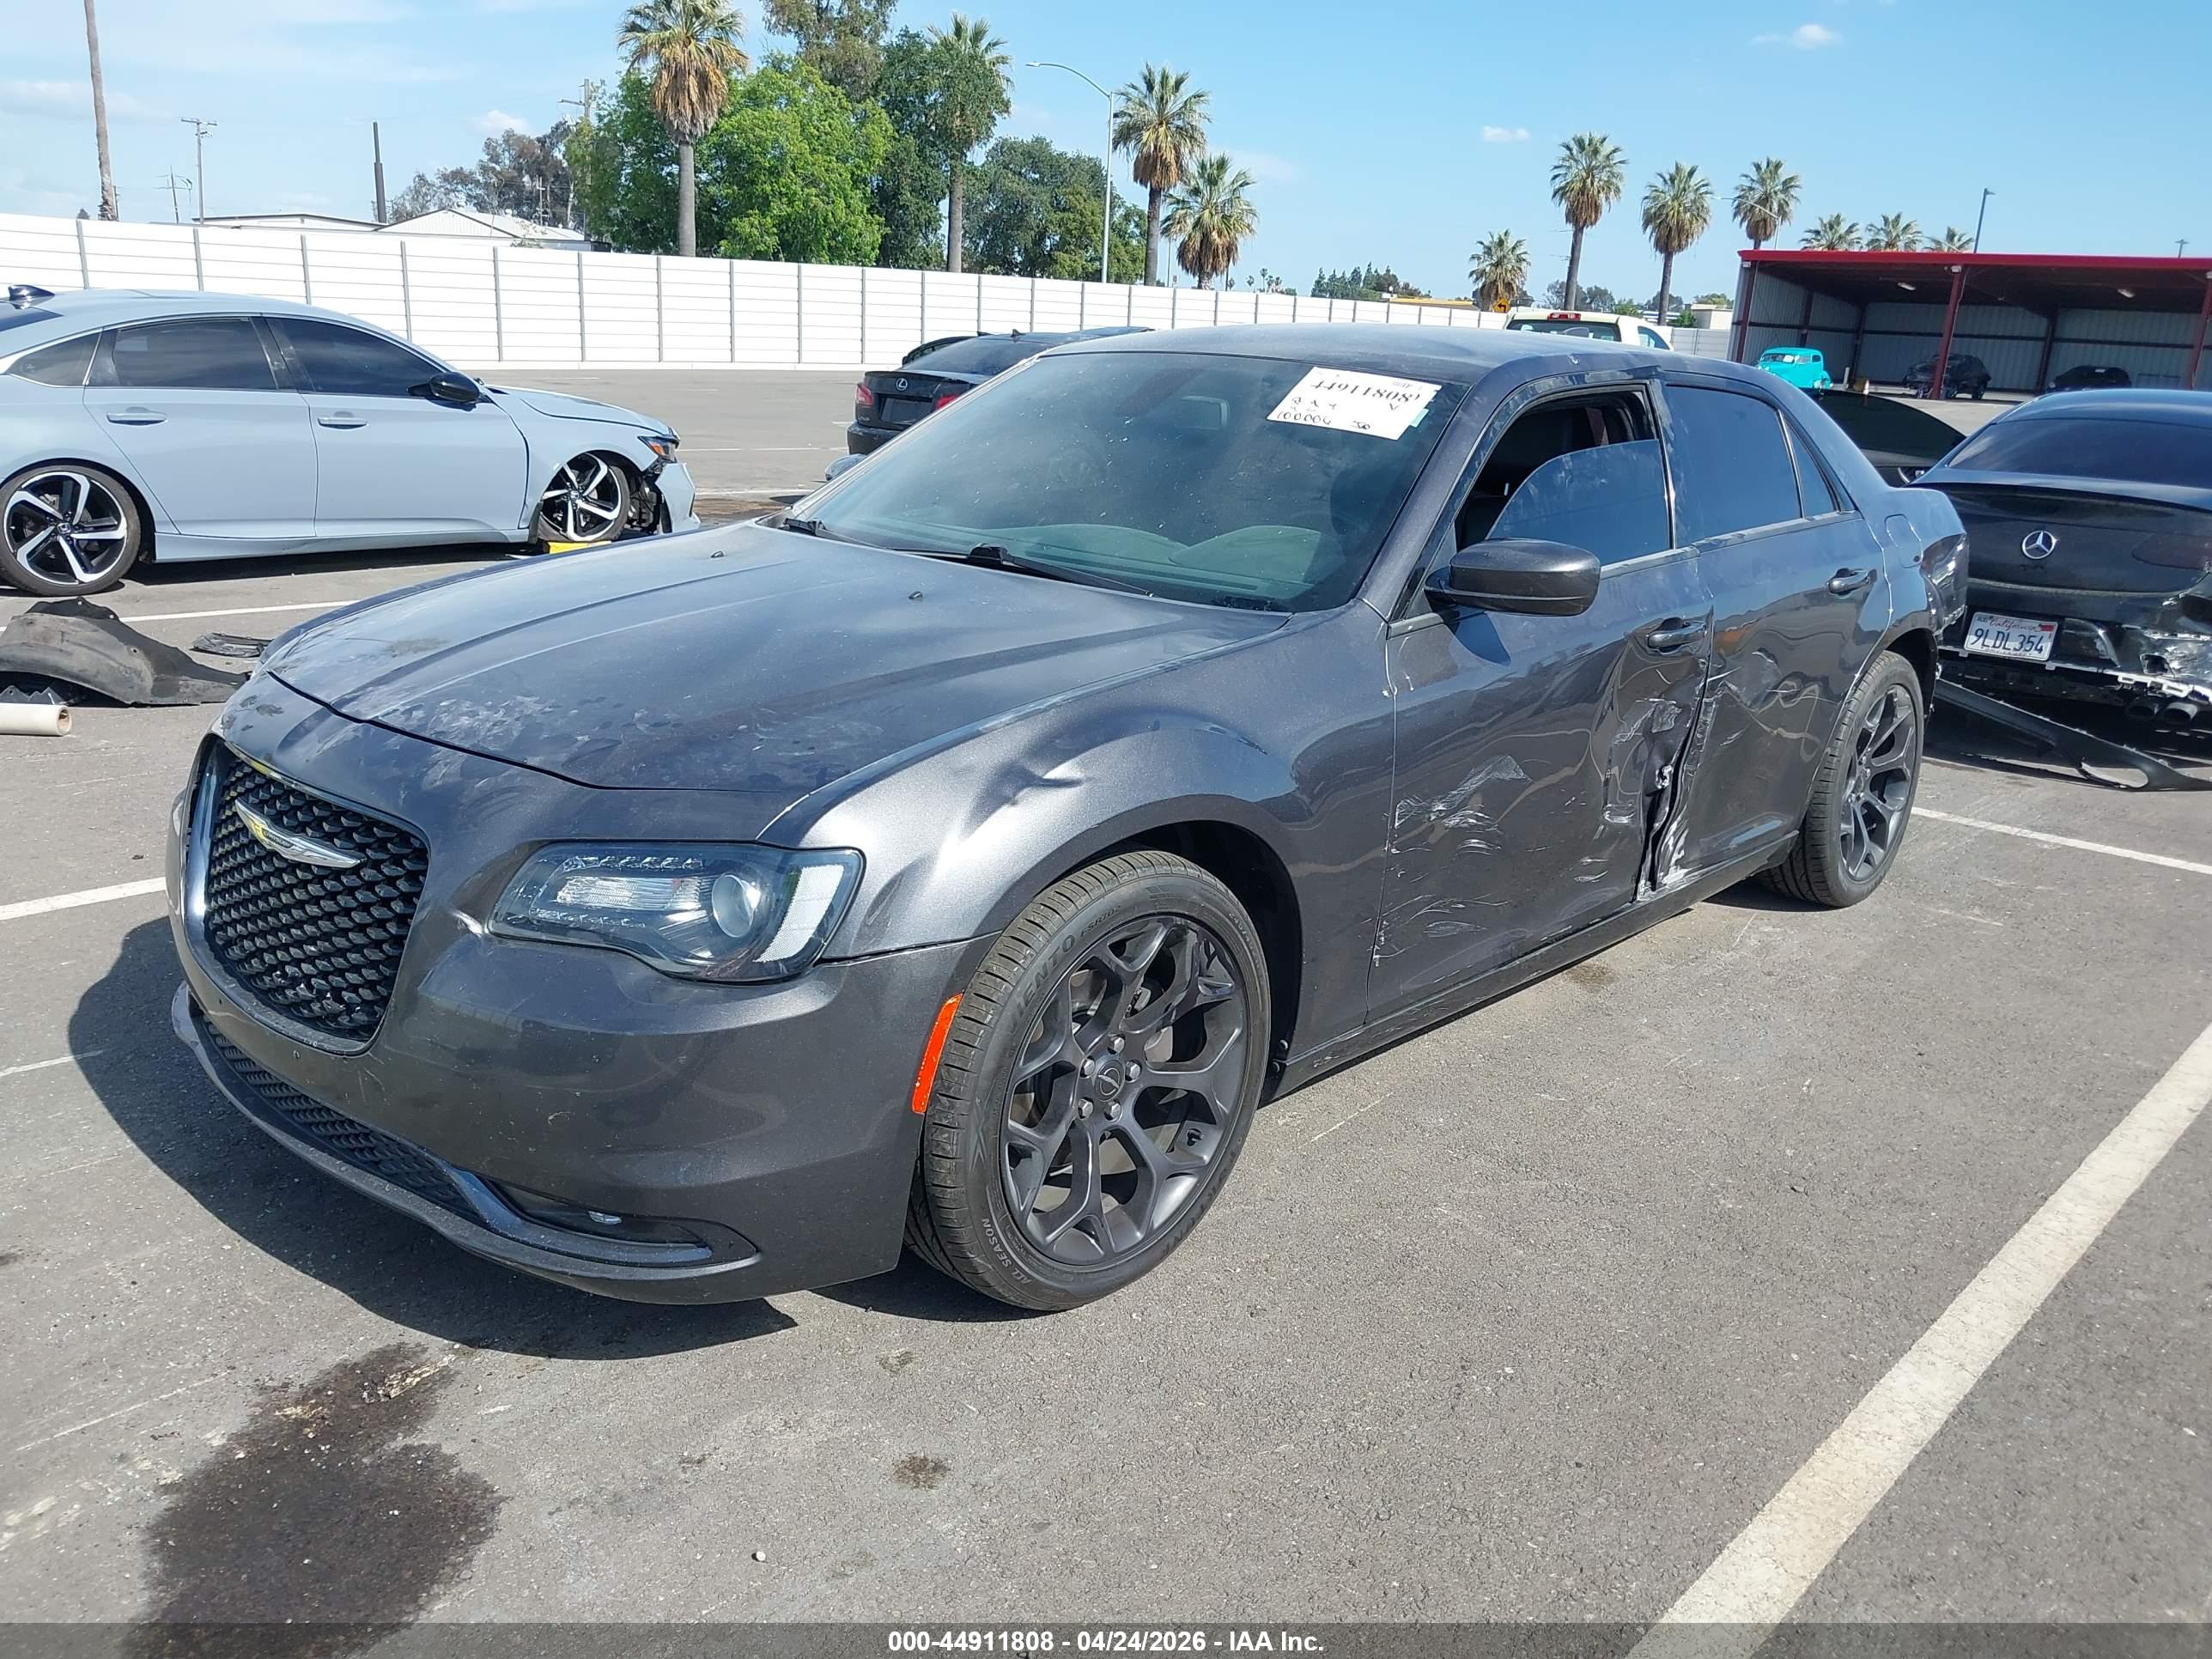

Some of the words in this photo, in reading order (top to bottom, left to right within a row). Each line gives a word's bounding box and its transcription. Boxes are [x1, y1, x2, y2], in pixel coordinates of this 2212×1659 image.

[1970, 628, 2044, 653] 9LDL354
[981, 1218, 1012, 1268] SEASON
[1011, 1267, 1032, 1285] ALL
